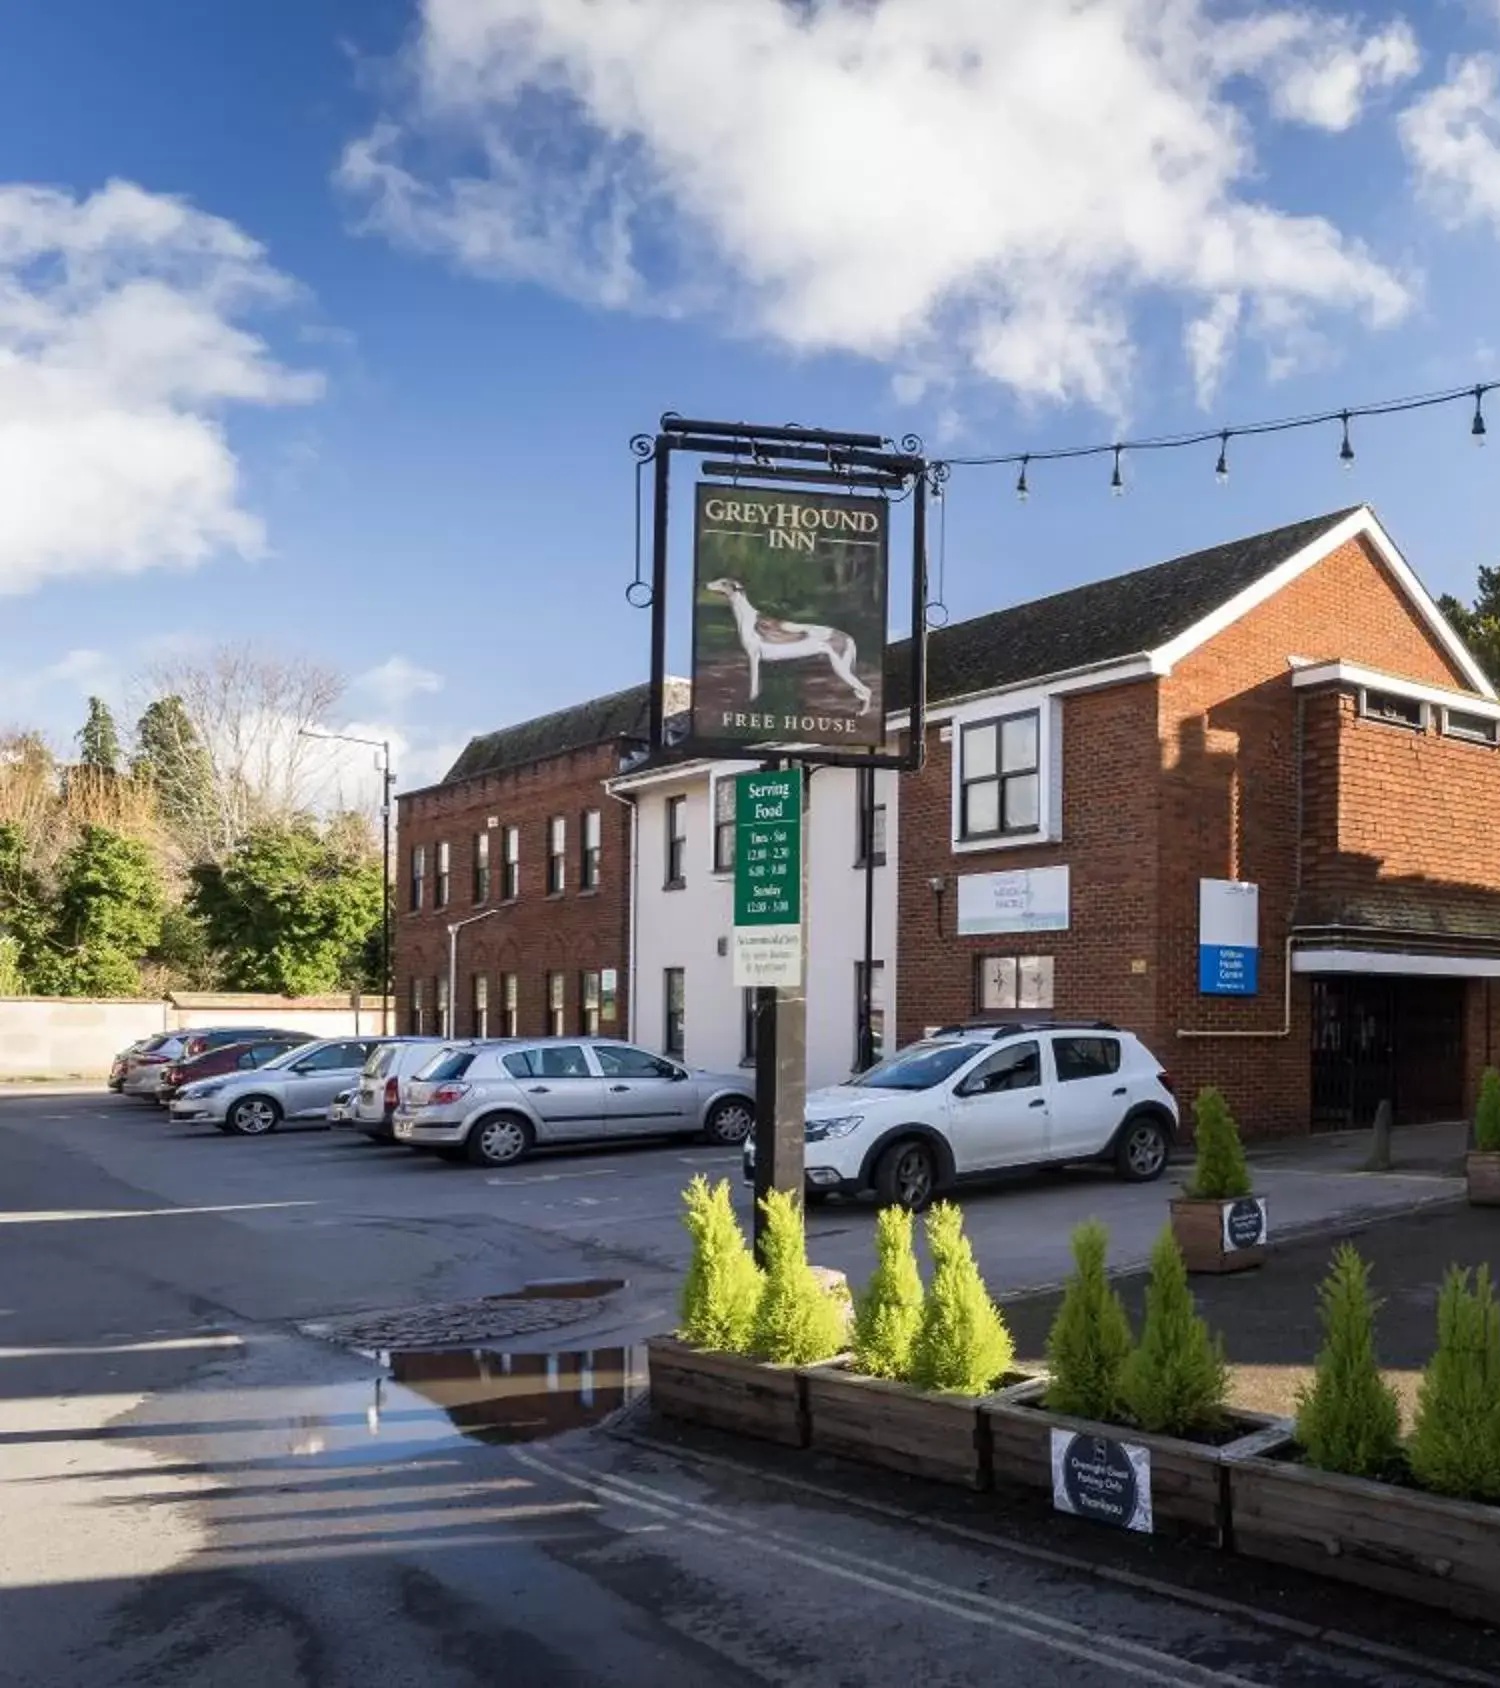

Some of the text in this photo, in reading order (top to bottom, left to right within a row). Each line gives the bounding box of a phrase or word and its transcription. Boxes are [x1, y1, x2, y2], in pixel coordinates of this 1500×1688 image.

[705, 499, 879, 533] GREYHOUND
[768, 529, 817, 551] INN
[722, 712, 857, 733] FREE HOUSE
[749, 781, 790, 800] Serving
[754, 801, 783, 819] Food
[753, 884, 782, 898] Sunday
